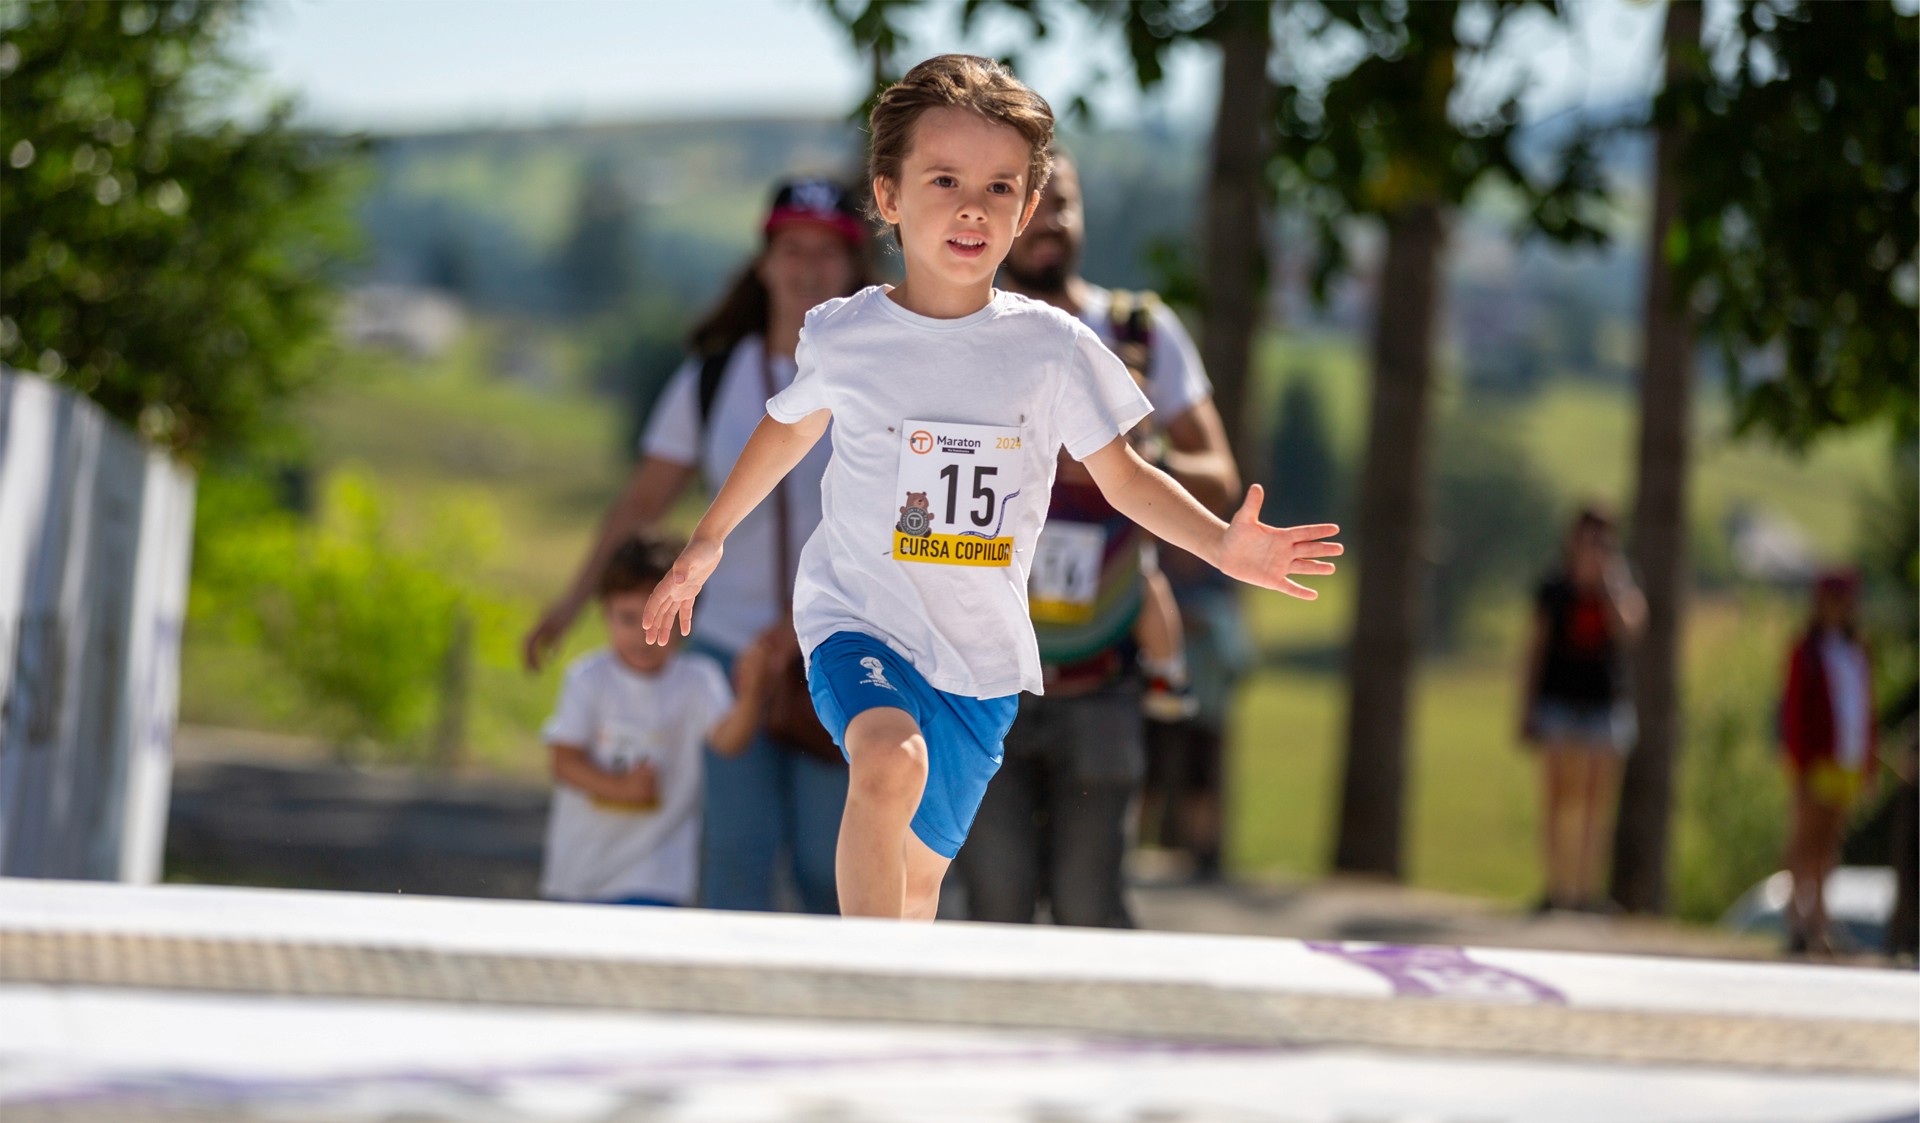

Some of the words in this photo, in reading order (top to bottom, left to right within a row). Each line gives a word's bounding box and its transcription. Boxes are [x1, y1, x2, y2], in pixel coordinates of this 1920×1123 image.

[937, 435, 981, 448] Maraton
[995, 437, 1021, 450] 2024
[940, 464, 998, 527] 15
[900, 537, 949, 559] CURSA
[955, 541, 1010, 561] COPIILOR
